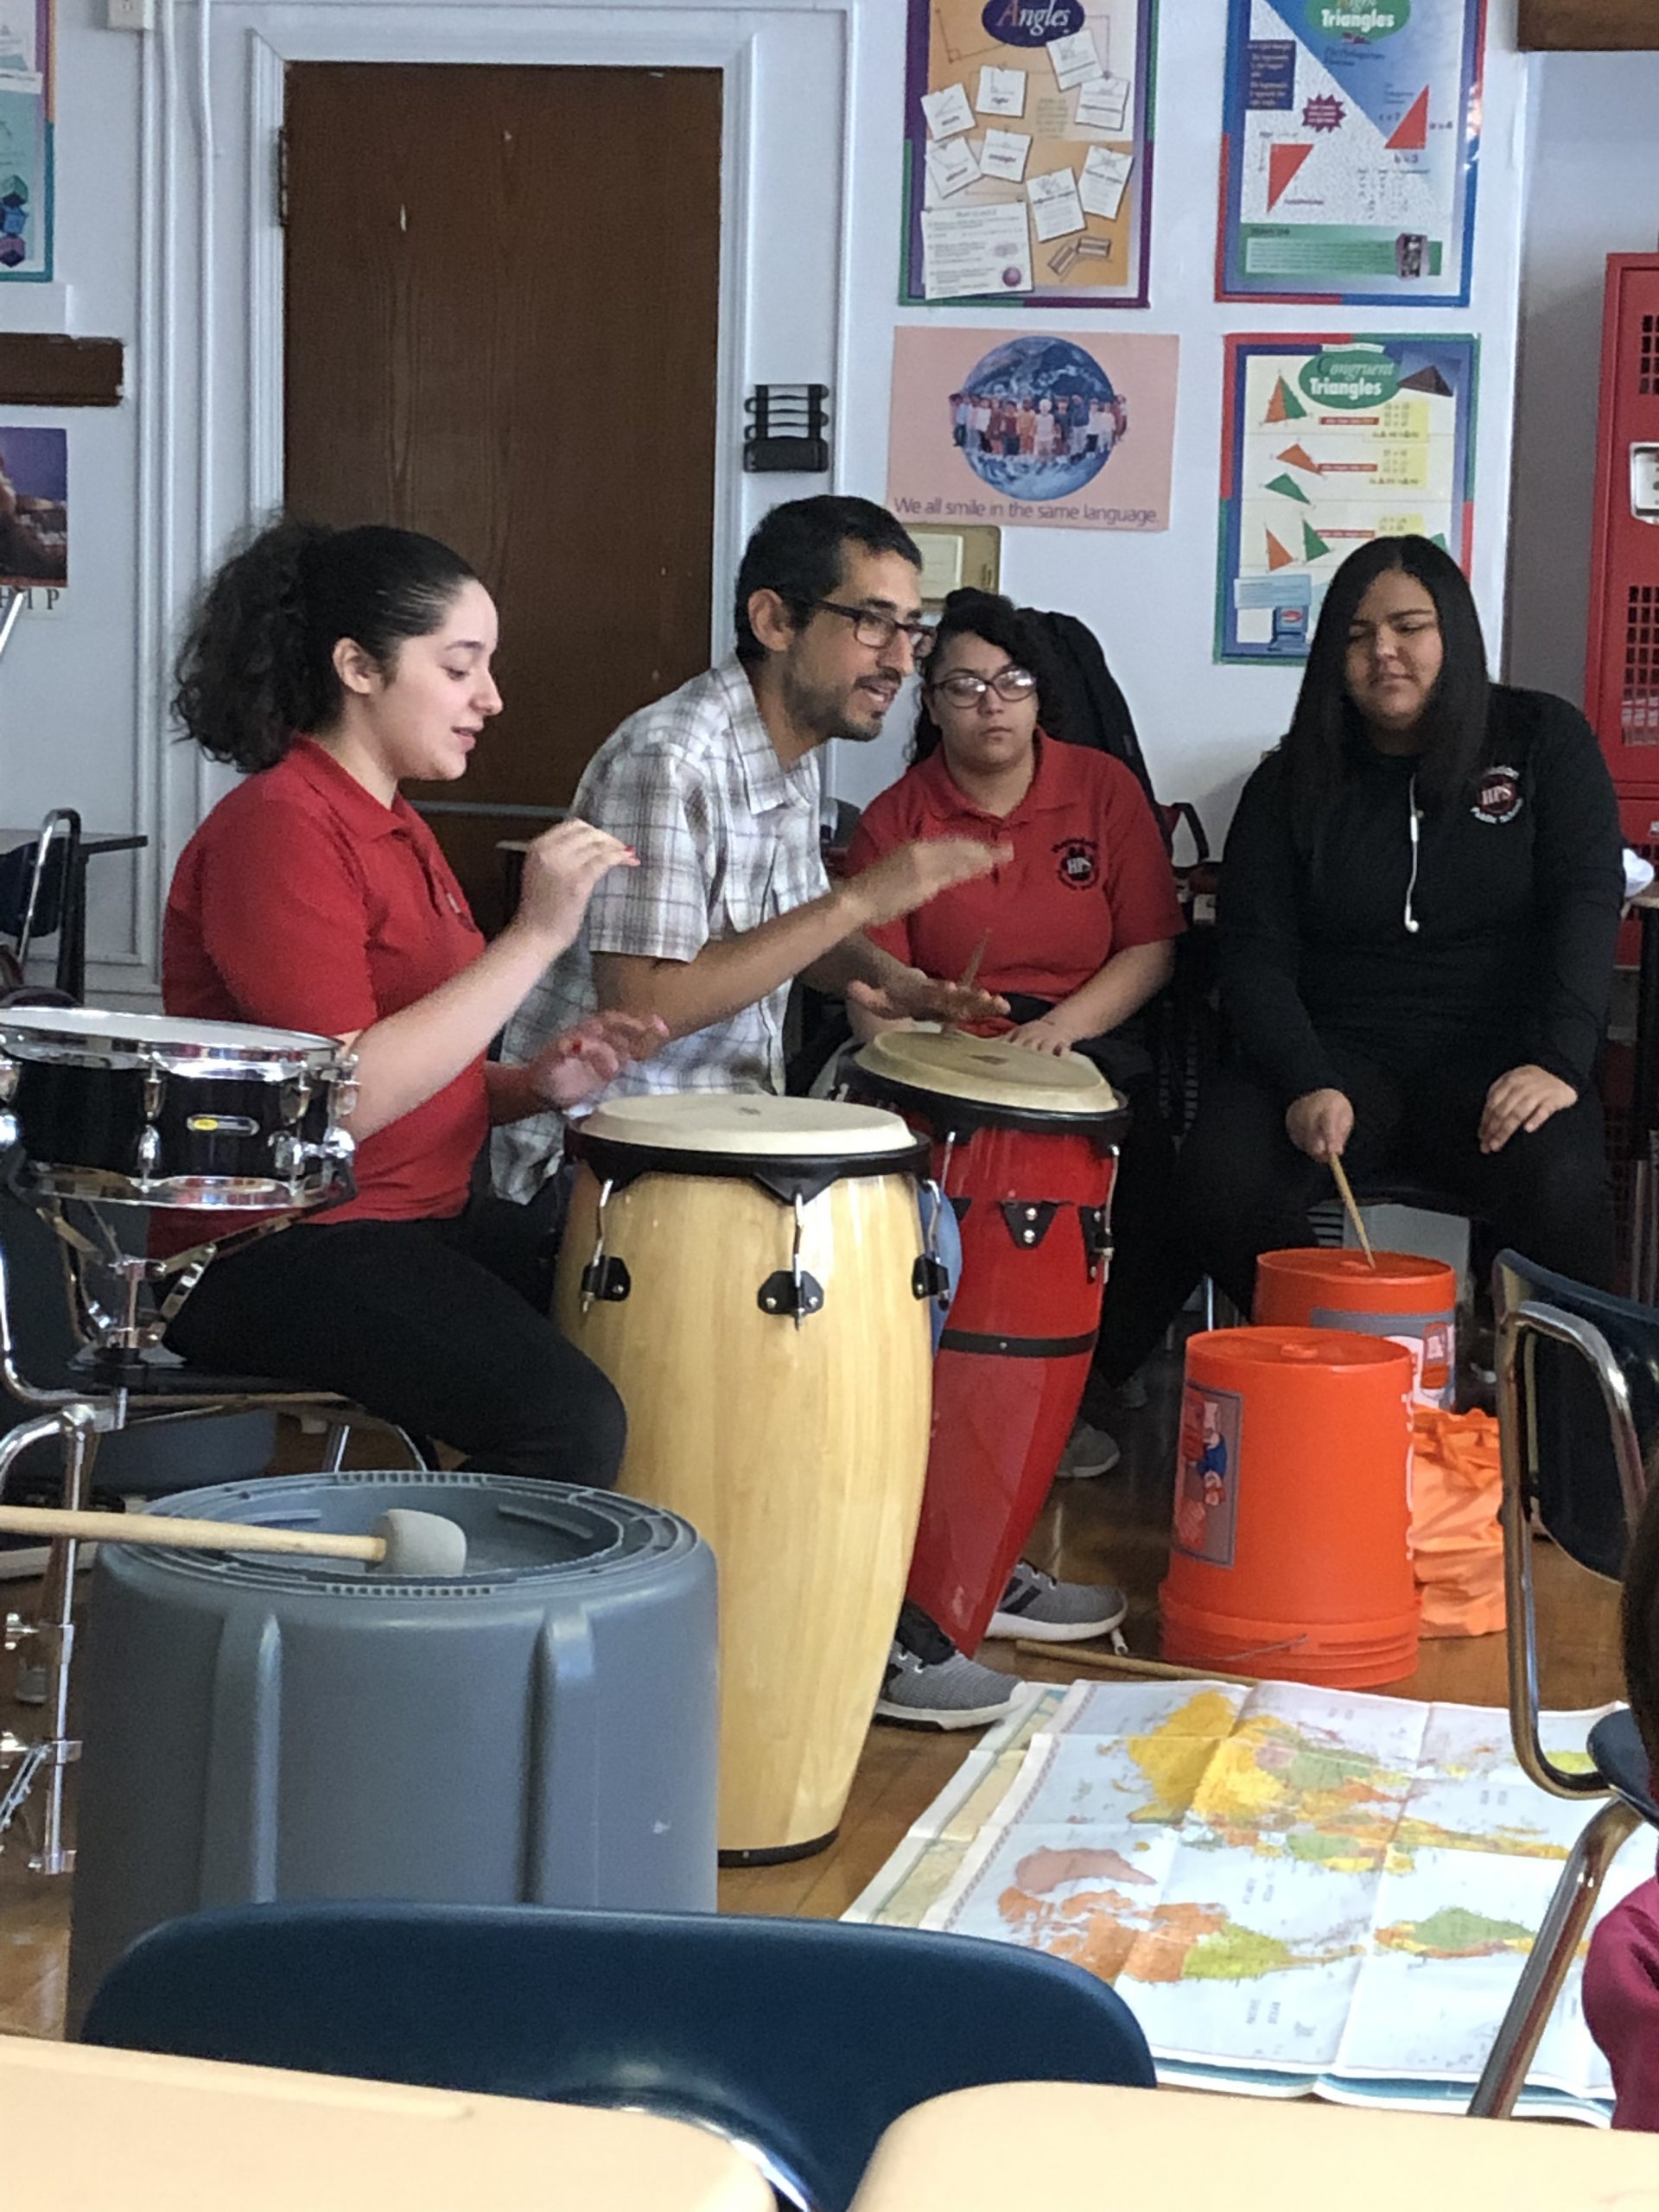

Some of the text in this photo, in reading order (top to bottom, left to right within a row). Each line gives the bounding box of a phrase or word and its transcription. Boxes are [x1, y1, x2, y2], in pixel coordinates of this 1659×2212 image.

[995, 0, 1071, 36] Angles
[1321, 8, 1395, 33] Triangles
[1318, 356, 1395, 380] Congruent
[1309, 378, 1382, 400] Triangles
[894, 497, 921, 515] We
[925, 498, 941, 514] all
[946, 499, 985, 516] smile
[990, 500, 1004, 516] in
[1008, 500, 1033, 518] the
[1038, 505, 1079, 519] same
